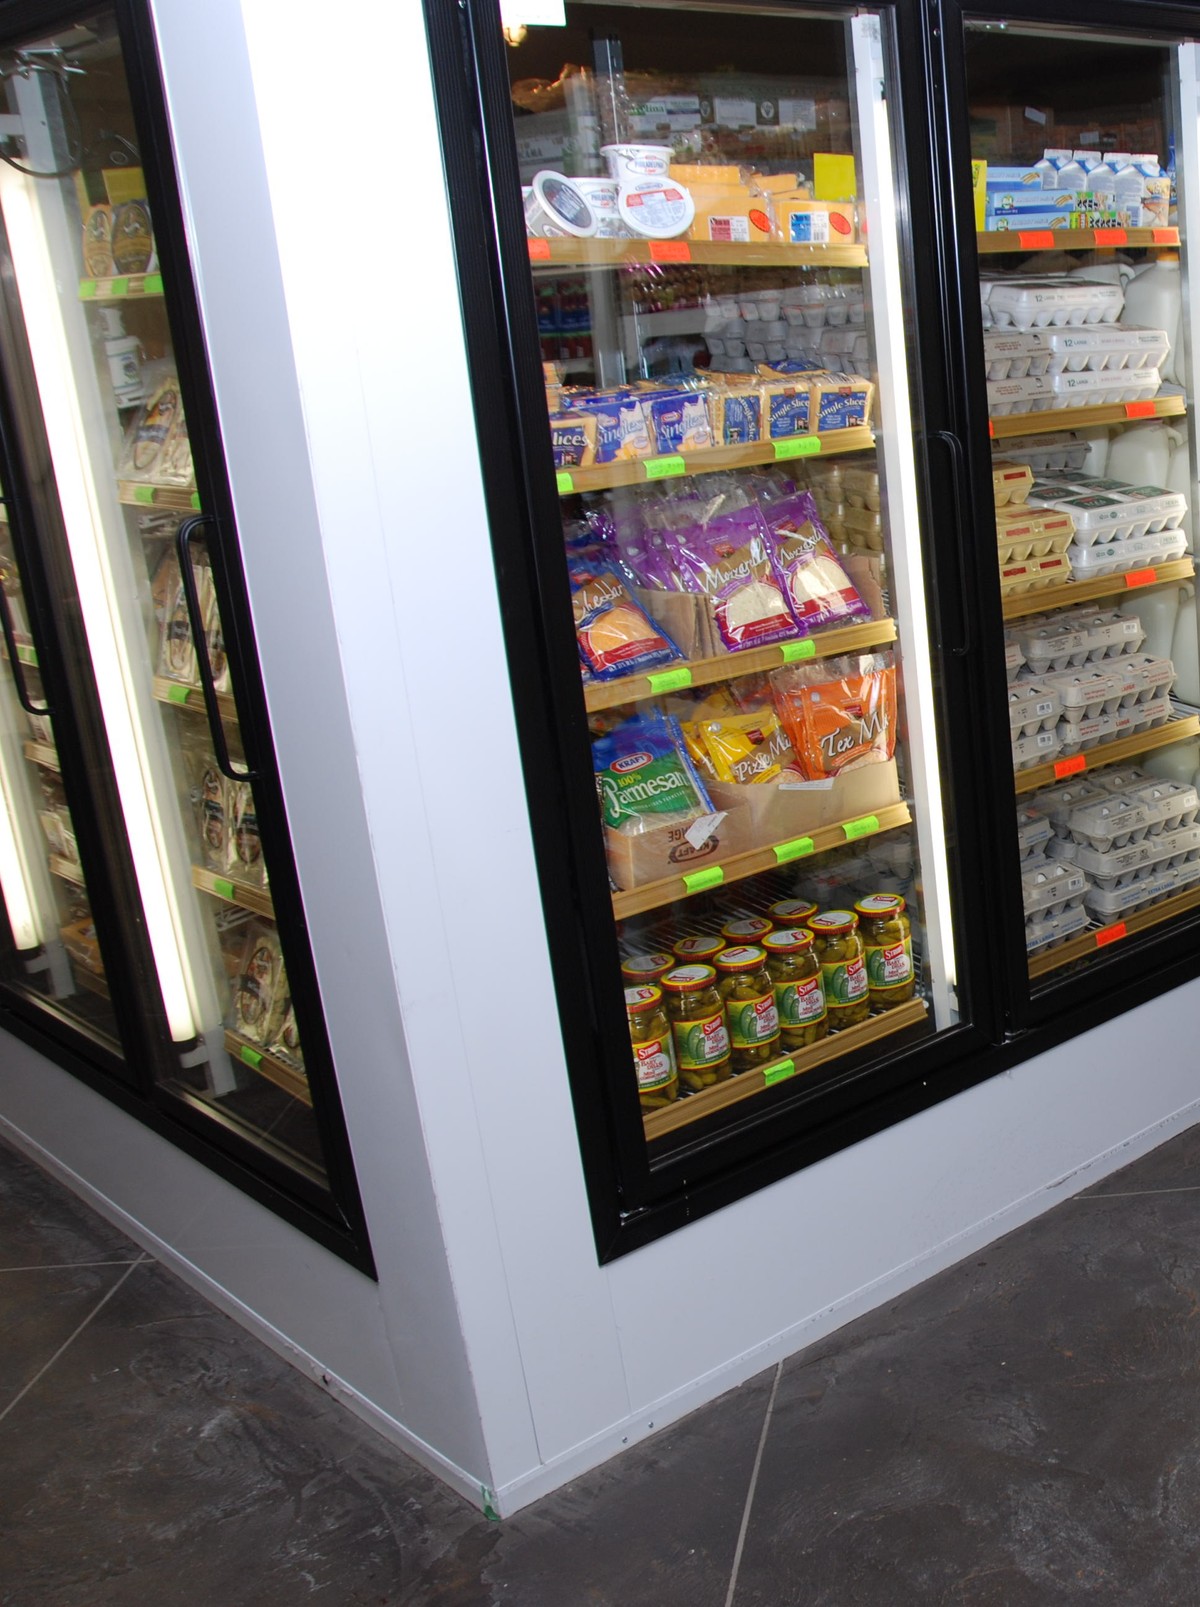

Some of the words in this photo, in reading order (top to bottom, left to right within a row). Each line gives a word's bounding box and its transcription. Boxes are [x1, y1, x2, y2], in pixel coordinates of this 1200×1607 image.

[1064, 339, 1073, 347] 12
[1067, 379, 1076, 388] 12
[552, 431, 589, 447] lices
[770, 734, 791, 761] Mi
[821, 727, 854, 757] Tex
[618, 755, 646, 769] KRAFT
[618, 772, 642, 787] 100%
[601, 771, 689, 819] Parmesan
